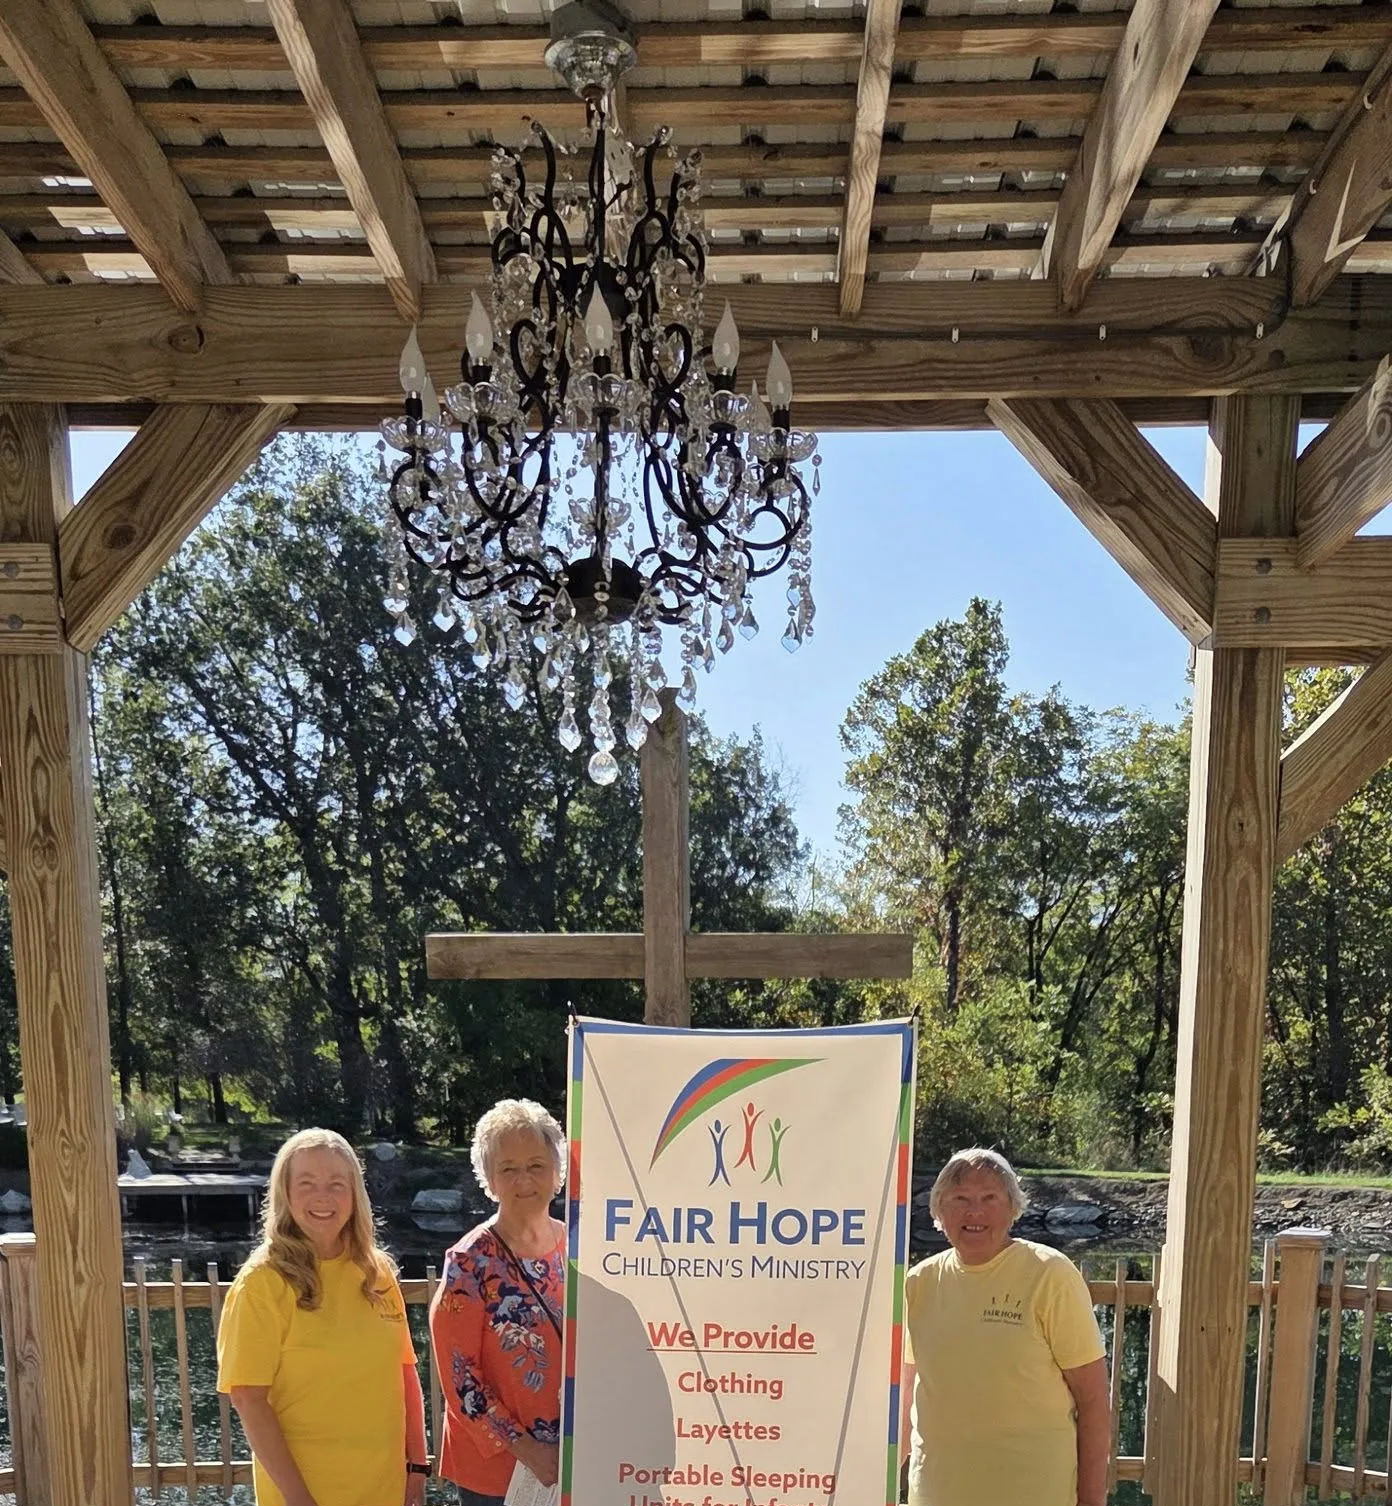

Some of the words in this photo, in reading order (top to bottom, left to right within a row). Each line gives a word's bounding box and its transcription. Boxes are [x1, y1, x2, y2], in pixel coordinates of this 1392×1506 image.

[604, 1199, 715, 1245] FAIR
[729, 1201, 866, 1246] HOPE
[602, 1252, 743, 1278] CHILDREN'S
[751, 1255, 866, 1280] MINISTRY
[647, 1322, 696, 1348] We
[703, 1323, 815, 1350] Provide
[678, 1372, 783, 1400] Clothing
[676, 1417, 781, 1444] Layettes
[618, 1463, 724, 1487] Portable
[731, 1465, 837, 1495] Sleeping
